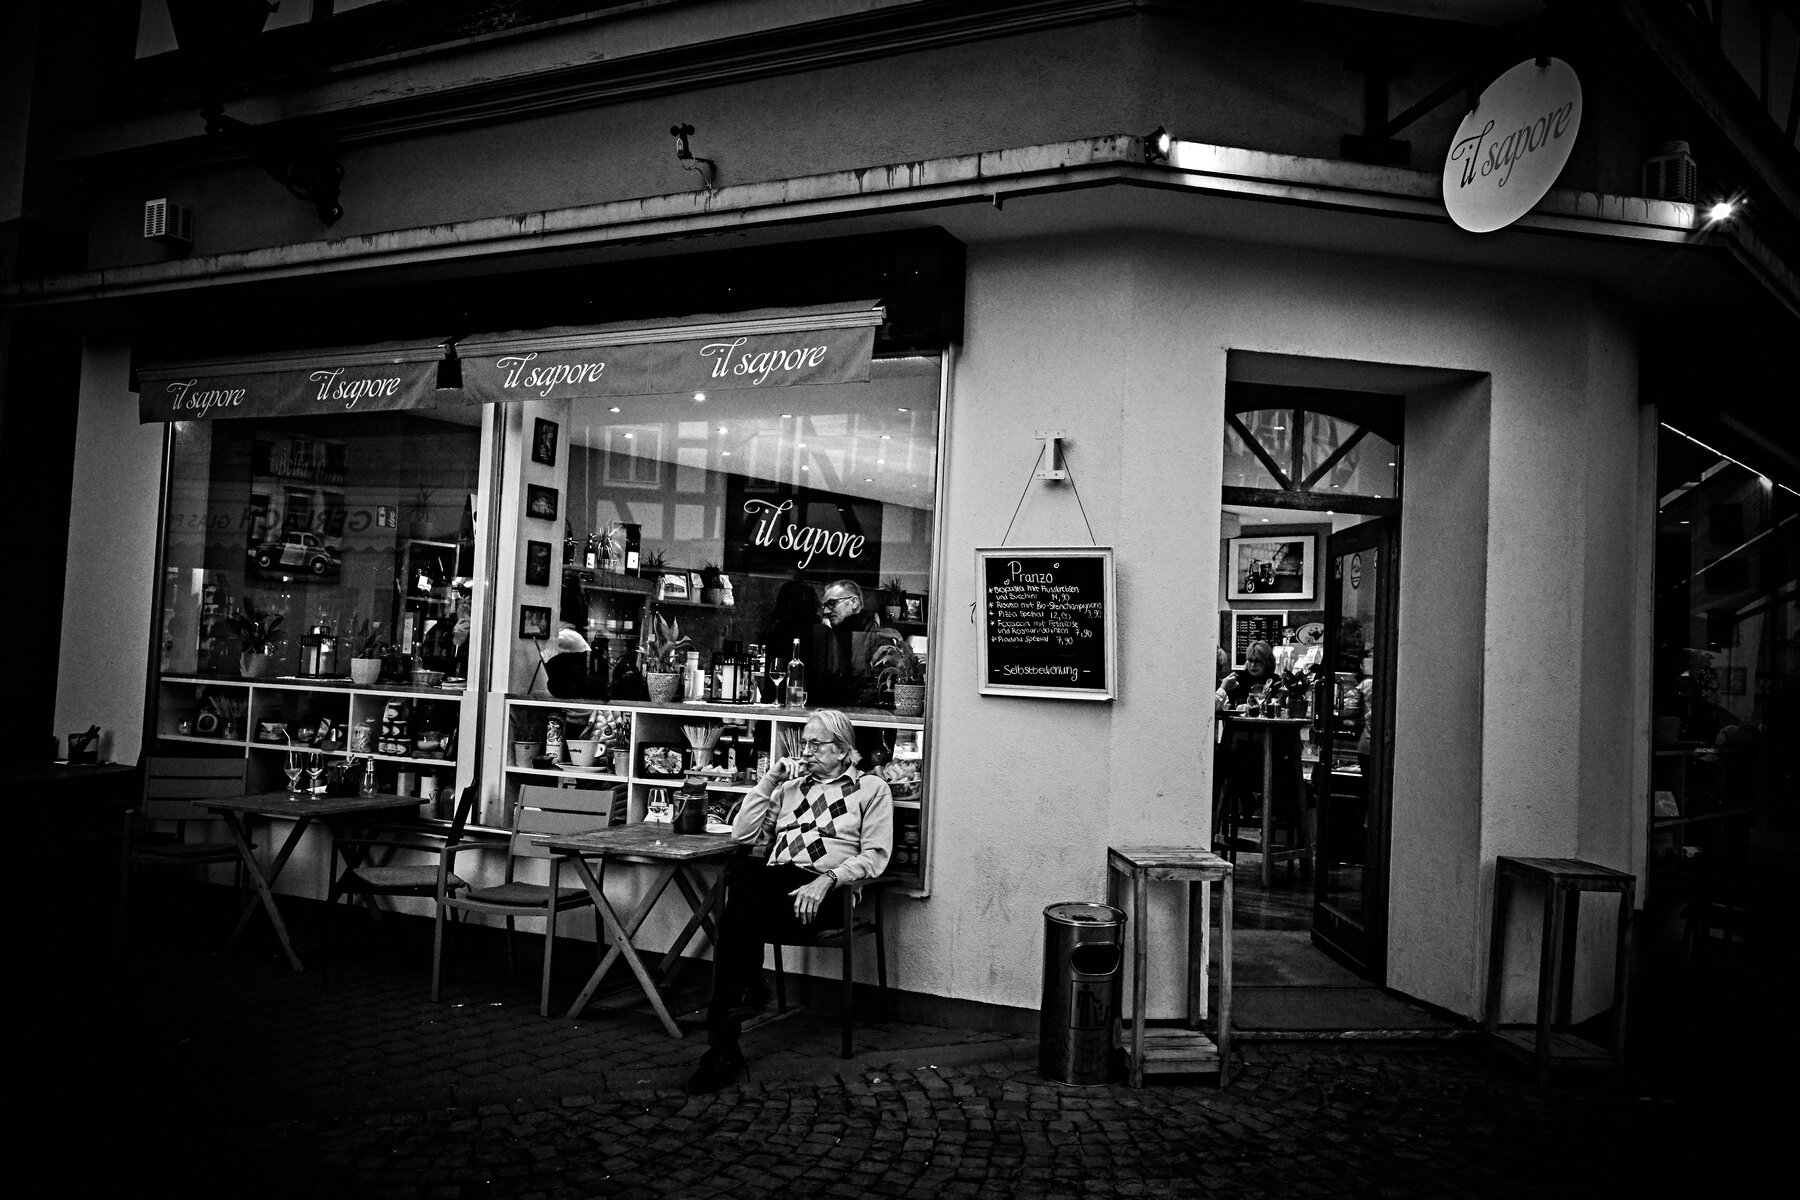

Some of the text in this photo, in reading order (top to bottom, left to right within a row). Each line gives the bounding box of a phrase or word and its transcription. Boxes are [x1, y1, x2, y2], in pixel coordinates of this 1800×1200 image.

[1451, 102, 1574, 189] il sapore
[697, 330, 828, 386] il sapore
[496, 351, 606, 398] il sapore
[166, 379, 246, 418] il sapore
[309, 367, 401, 410] il sapore
[743, 498, 867, 570] il sapore
[1007, 560, 1053, 583] Pranzo
[1026, 584, 1040, 593] mit
[997, 609, 1018, 618] Pizza
[1020, 601, 1035, 609] mit
[997, 627, 1011, 635] und
[1074, 628, 1093, 638] 7,90
[1033, 619, 1047, 627] mit
[1055, 636, 1074, 646] 7,90
[1003, 665, 1079, 682] Selbstbedienung
